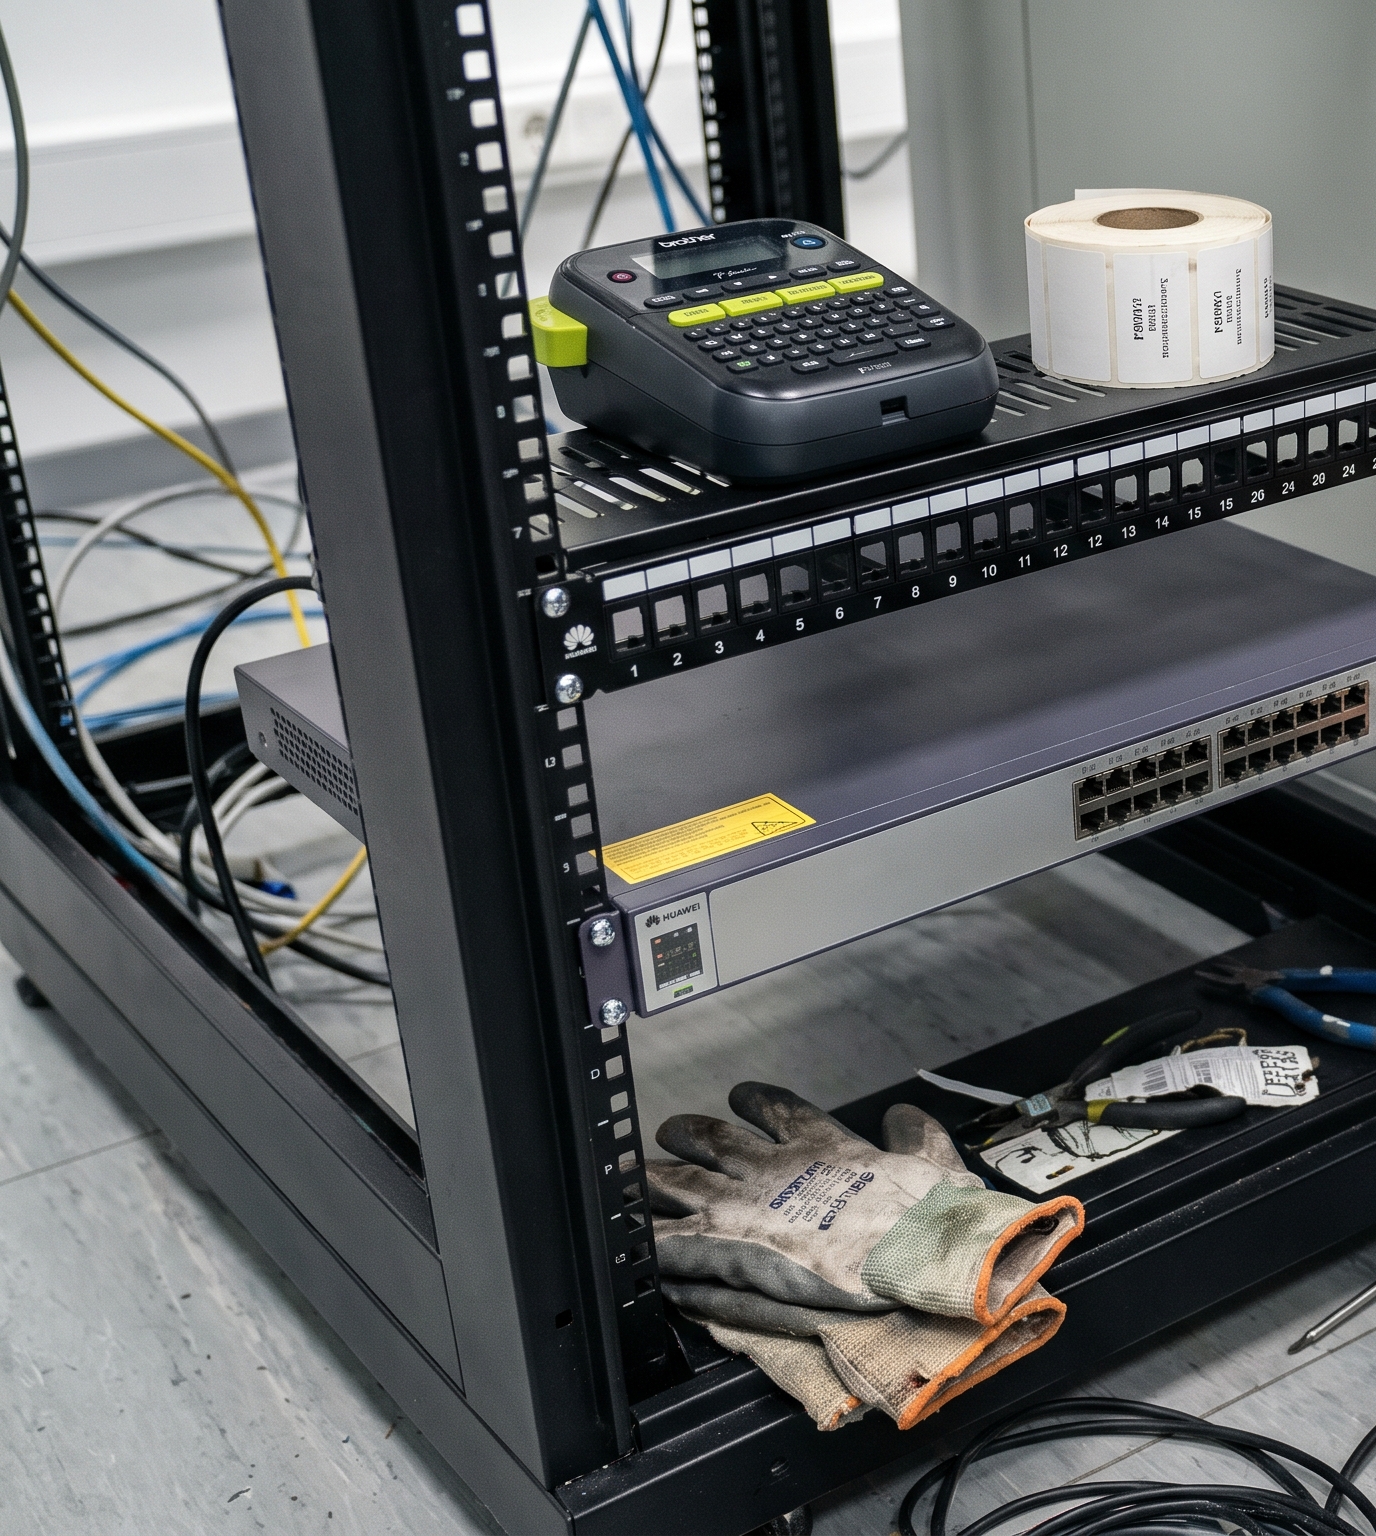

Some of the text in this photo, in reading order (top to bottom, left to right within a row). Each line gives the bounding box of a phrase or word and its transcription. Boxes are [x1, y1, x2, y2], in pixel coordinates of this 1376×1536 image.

[630, 664, 638, 678] 1
[672, 652, 683, 667] 2
[714, 640, 725, 654] 3
[754, 628, 766, 643] 4
[795, 617, 805, 631] 5
[834, 606, 845, 620] 6
[873, 595, 883, 609] 7
[910, 585, 921, 599] 8
[948, 574, 958, 588] 9
[982, 564, 997, 578] 10
[1018, 555, 1031, 568] 11
[1053, 545, 1068, 558] 12
[1088, 535, 1103, 548] 12
[1122, 526, 1136, 538] 13
[1155, 516, 1169, 529] 14
[1188, 507, 1201, 520] 15
[1220, 498, 1233, 511] 15
[1282, 480, 1295, 494] 24
[1342, 464, 1355, 478] 24
[663, 902, 701, 922] HUAWEI
